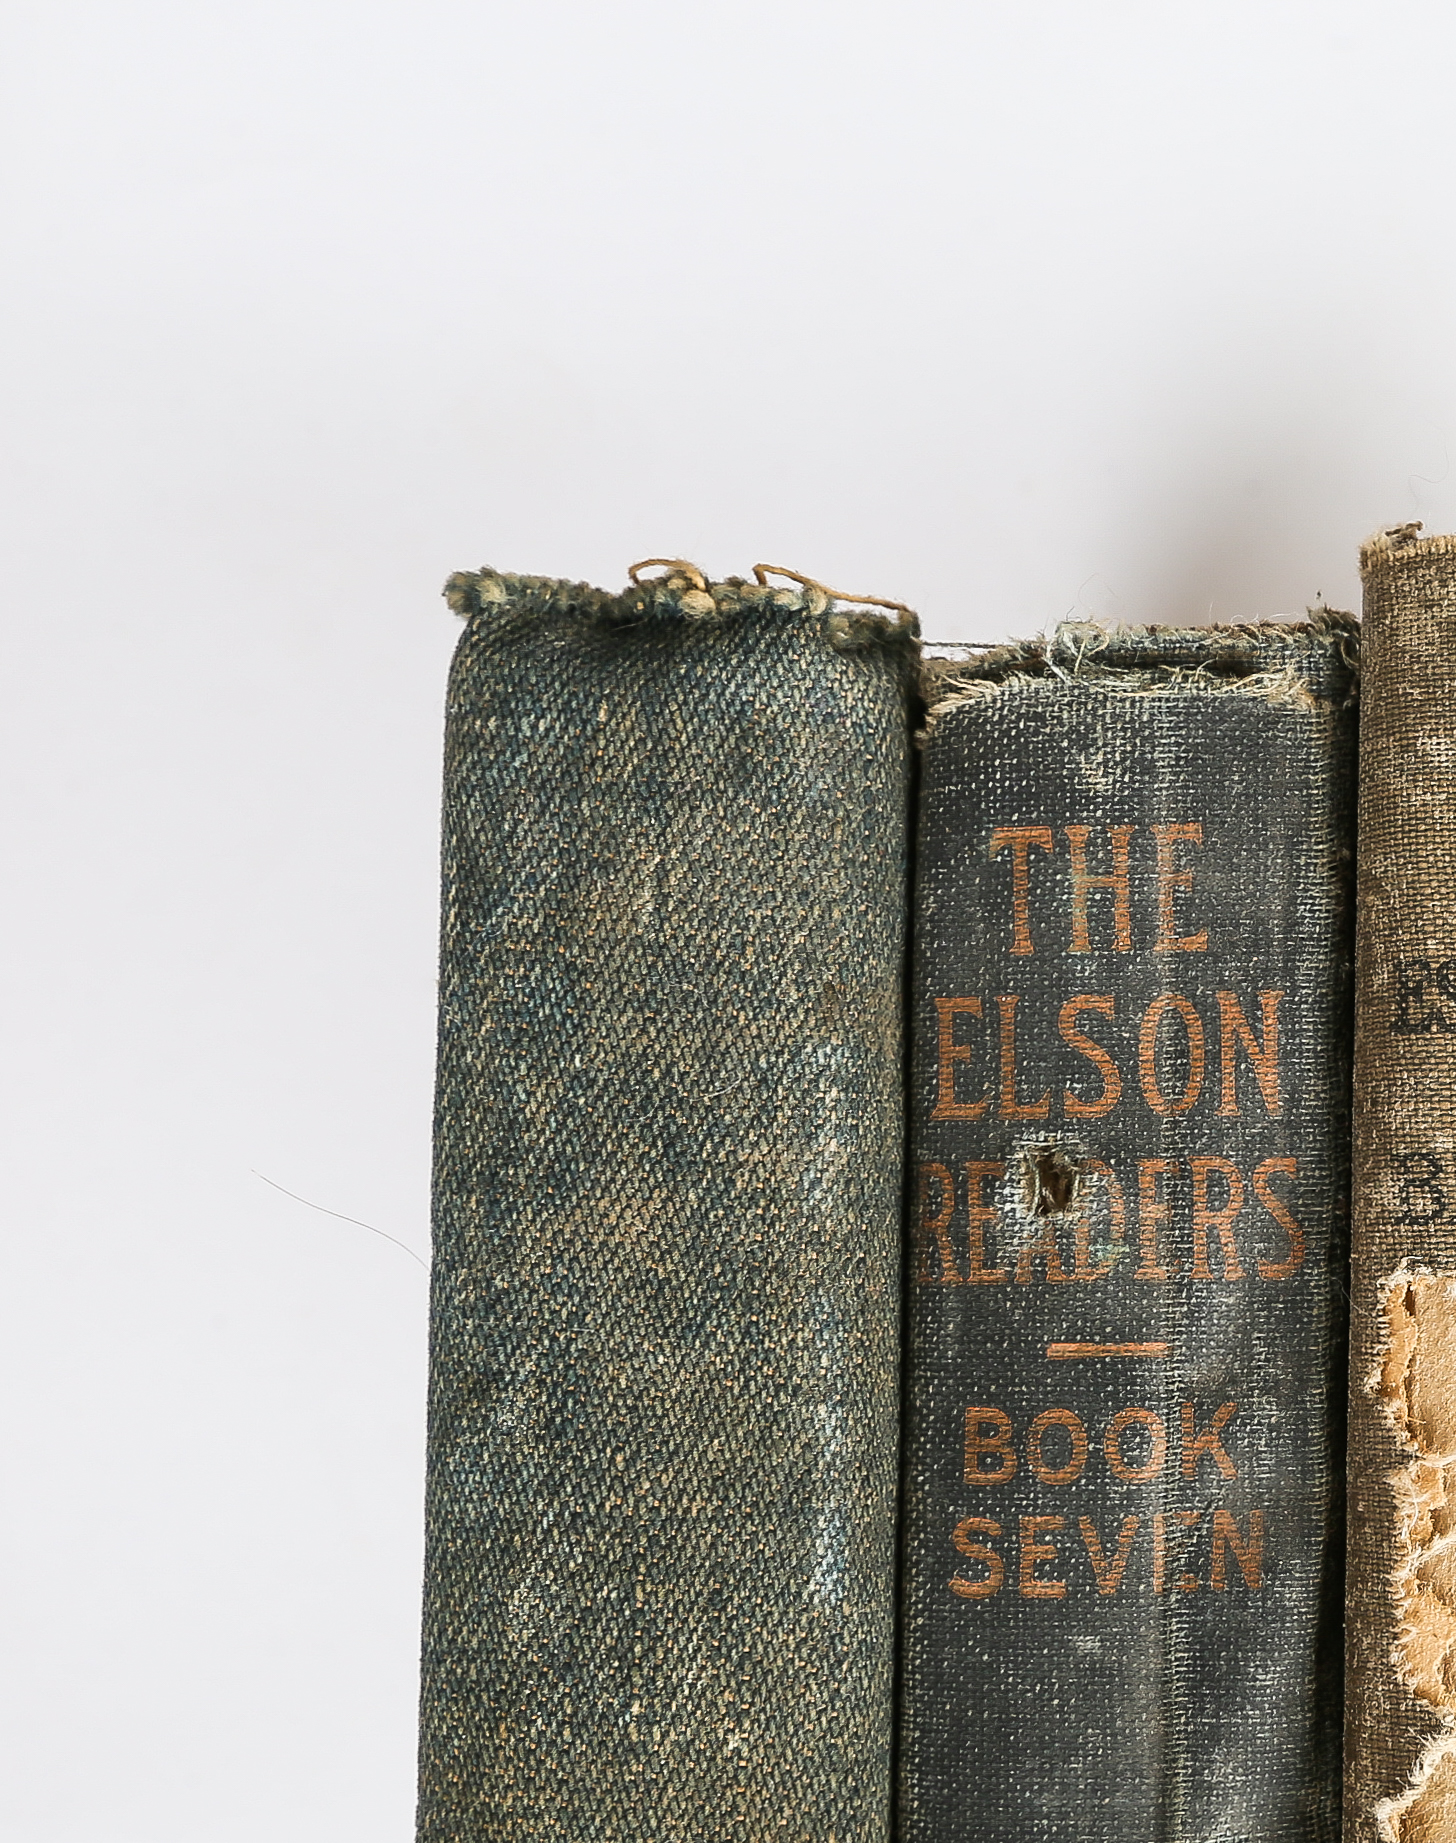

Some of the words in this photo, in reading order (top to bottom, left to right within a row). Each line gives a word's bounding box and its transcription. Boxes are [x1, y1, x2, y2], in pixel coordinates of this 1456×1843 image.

[988, 822, 1209, 956] THE
[928, 990, 1286, 1121] ELSON
[963, 1401, 1239, 1486] BOOK
[947, 1508, 1266, 1600] SEVEN
